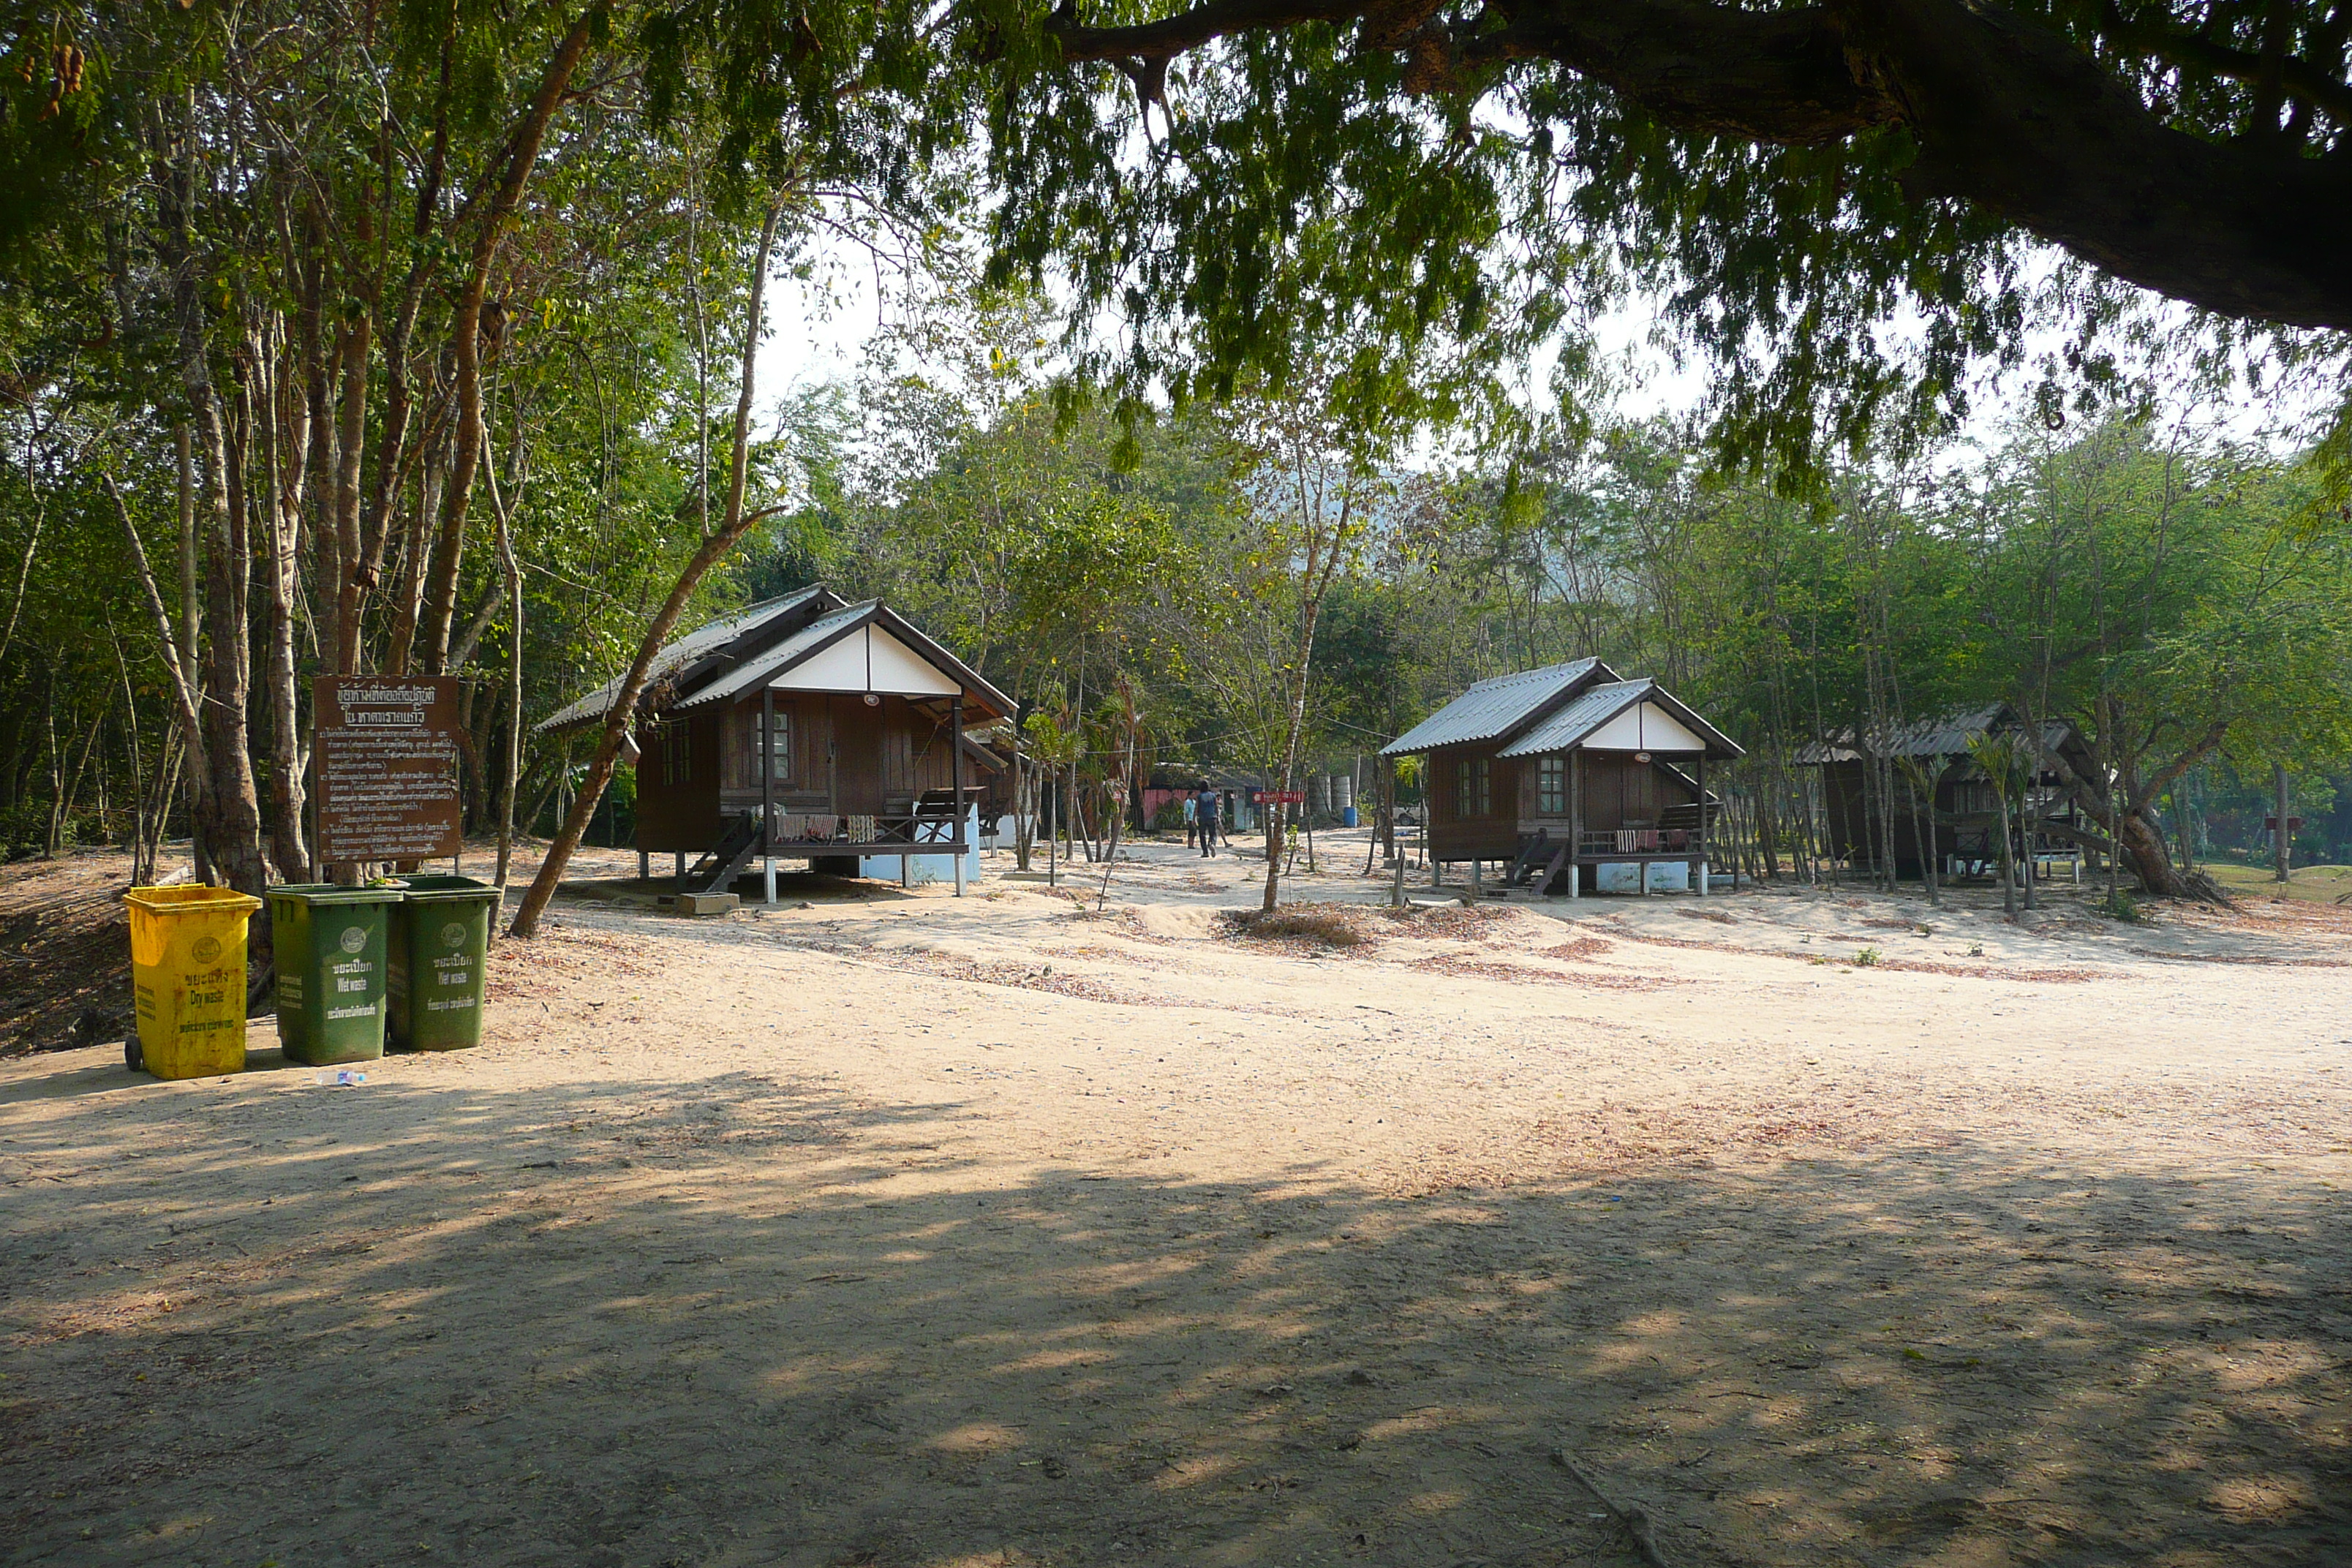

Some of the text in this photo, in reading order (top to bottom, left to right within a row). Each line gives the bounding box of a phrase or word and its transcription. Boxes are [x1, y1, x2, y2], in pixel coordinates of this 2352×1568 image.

[341, 704, 425, 724] ใน หาดทรายแก้ว
[332, 958, 372, 974] ขยะเปียก
[433, 952, 472, 968] ขยะเปียก
[337, 977, 367, 992] Wet waste
[437, 970, 467, 986] Wet waste
[190, 990, 224, 1009] Dry waste
